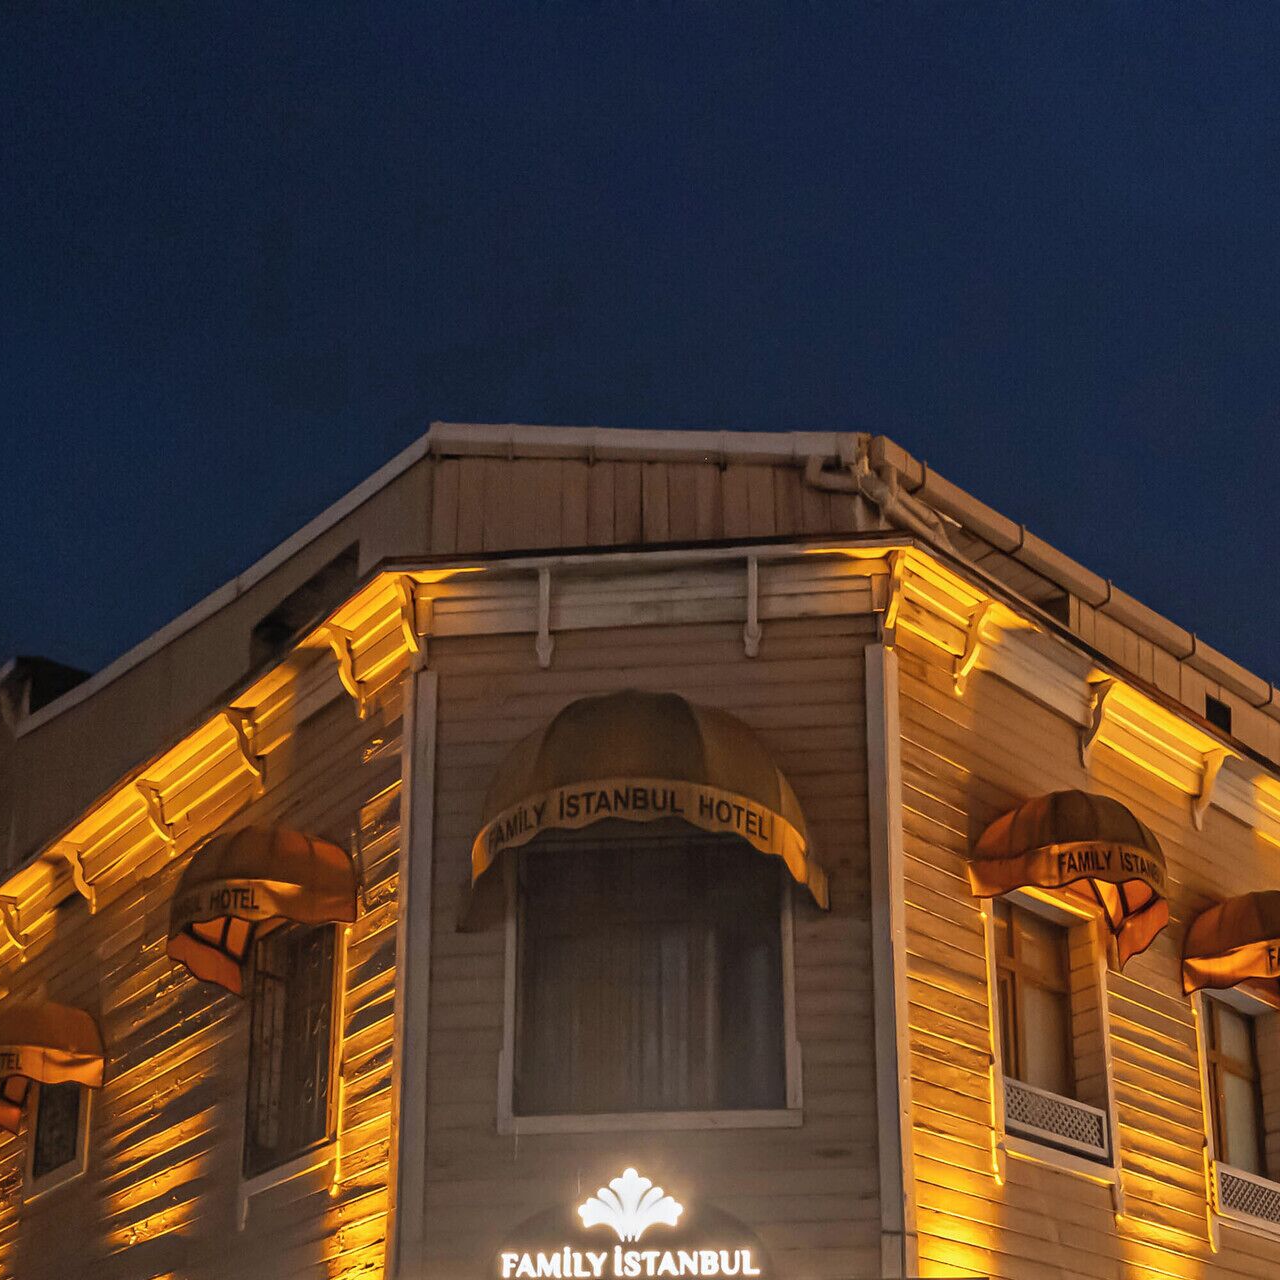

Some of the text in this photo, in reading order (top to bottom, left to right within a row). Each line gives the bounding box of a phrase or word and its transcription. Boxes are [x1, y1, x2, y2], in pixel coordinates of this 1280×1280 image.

[558, 787, 685, 821] İSTANBUL
[698, 796, 769, 842] HOTEL
[210, 888, 260, 911] HOTEL
[501, 1244, 760, 1280] FAMİLY İSTANBUL
